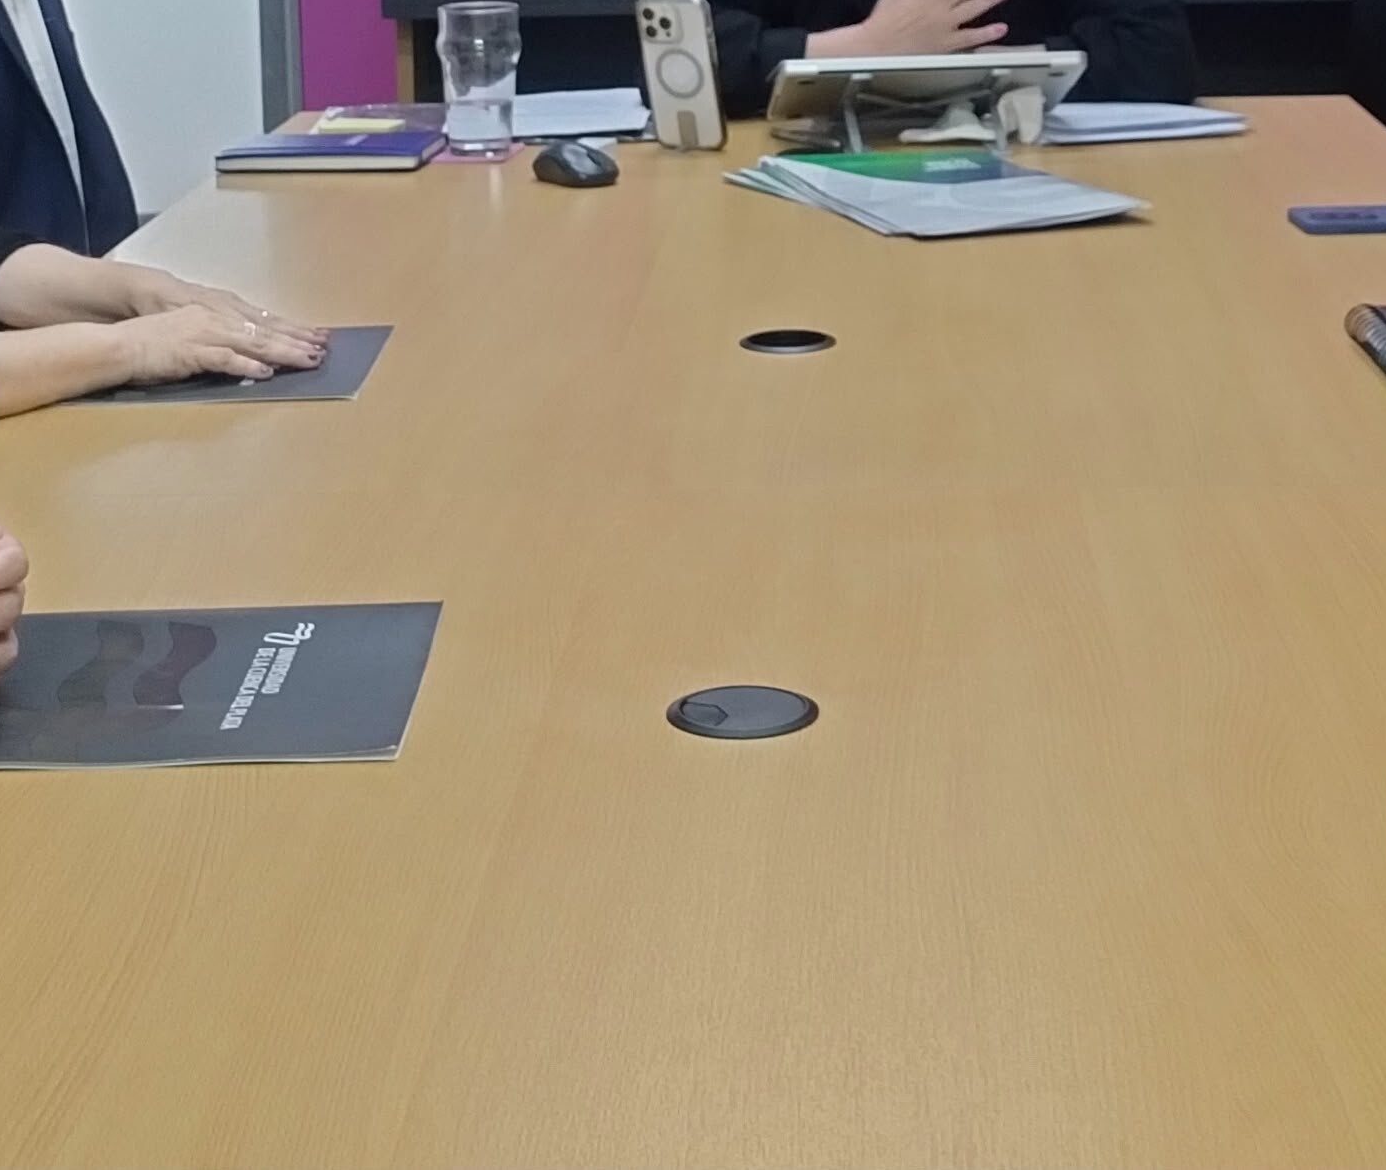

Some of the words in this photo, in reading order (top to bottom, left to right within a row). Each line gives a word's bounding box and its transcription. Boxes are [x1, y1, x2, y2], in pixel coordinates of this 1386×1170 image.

[256, 647, 276, 658] DE
[251, 658, 272, 668] LA
[261, 647, 297, 694] UNIVERSIDAD
[236, 668, 267, 696] CUENCA
[230, 695, 255, 708] DEL
[219, 708, 248, 730] PLATA
